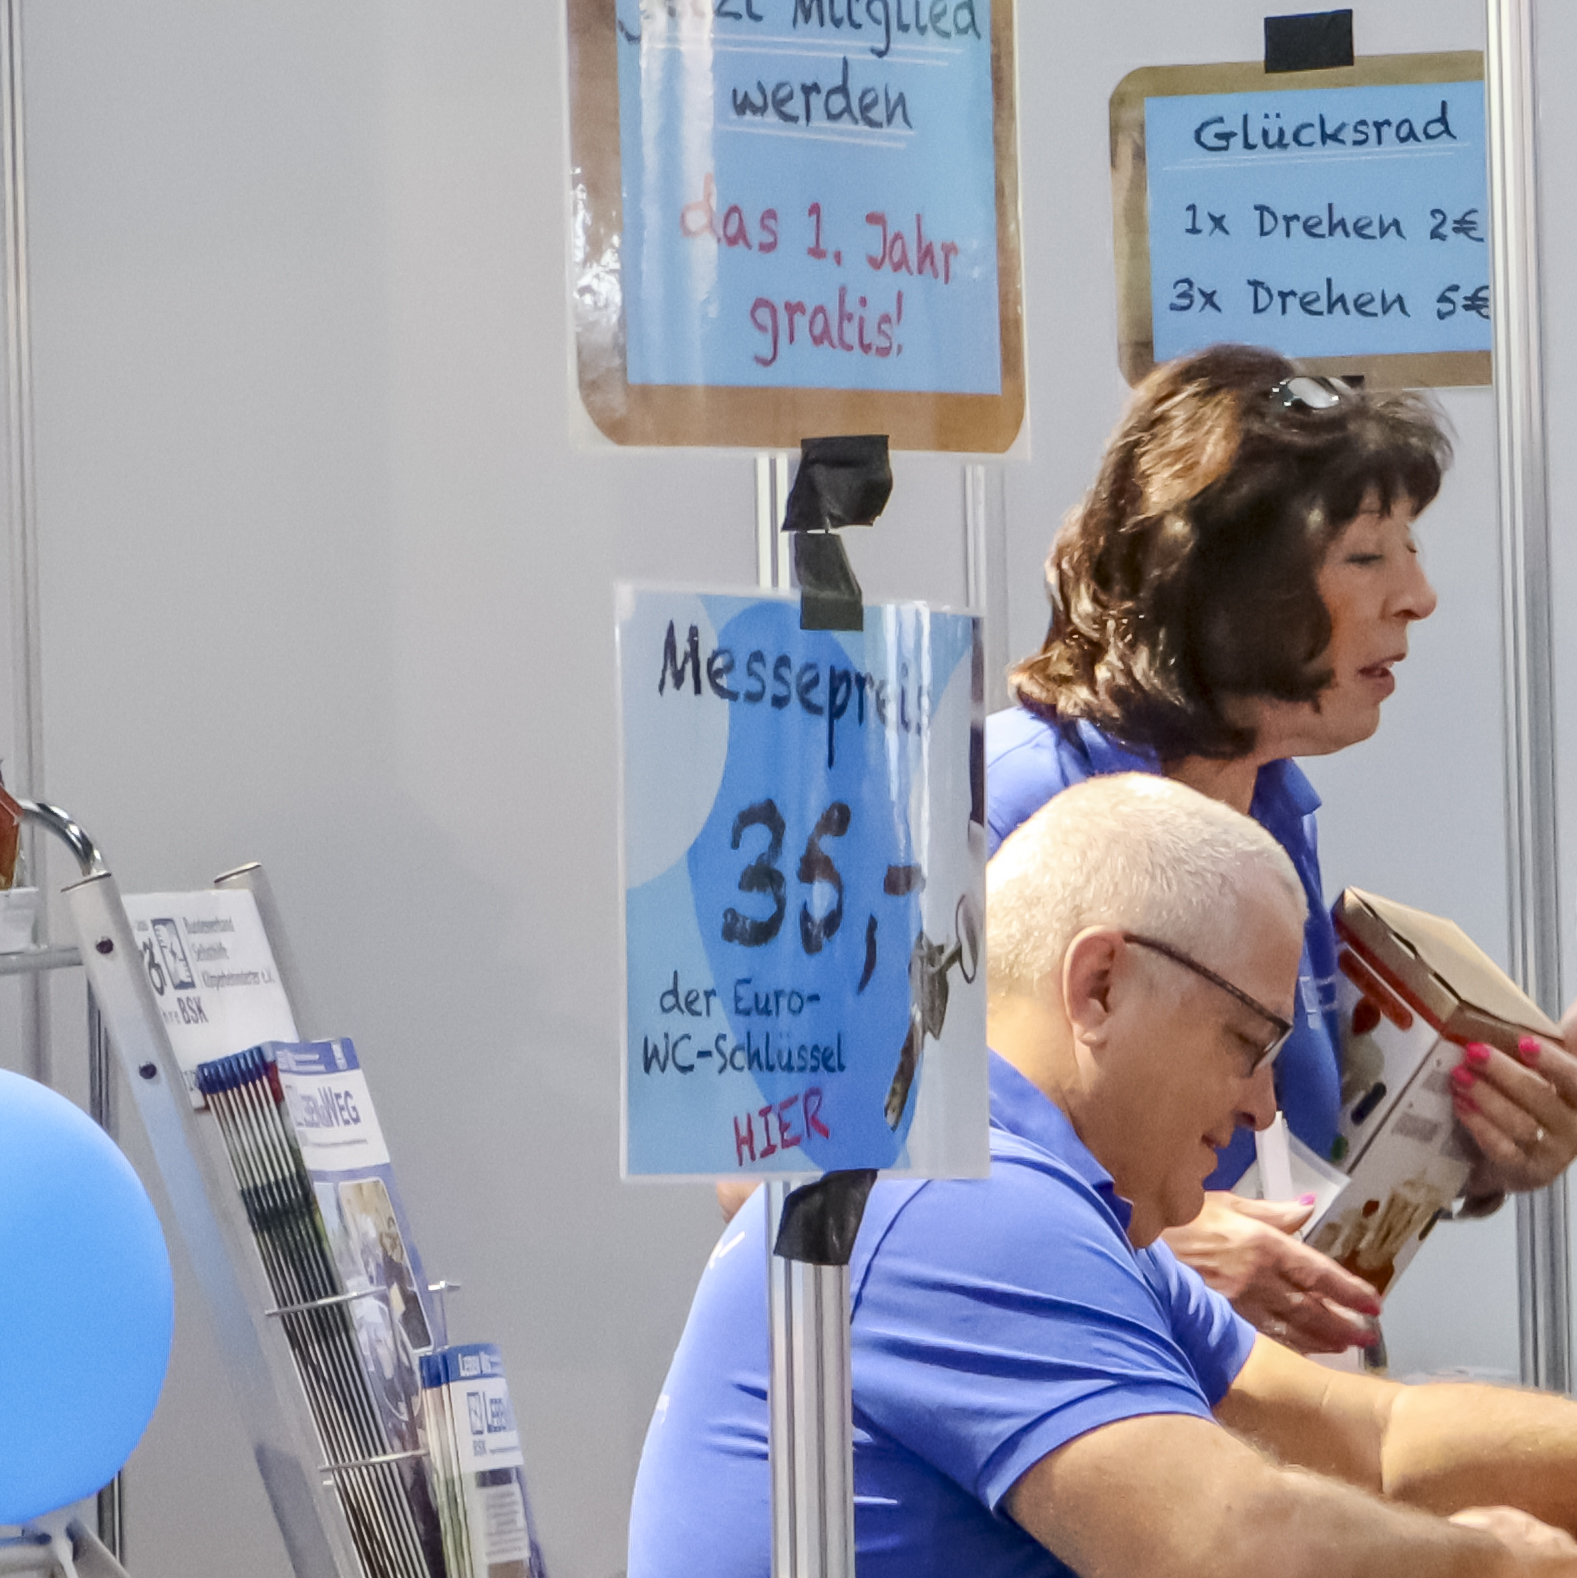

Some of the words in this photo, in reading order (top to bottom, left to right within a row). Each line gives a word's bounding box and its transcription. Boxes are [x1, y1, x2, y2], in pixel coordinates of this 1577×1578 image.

[732, 56, 913, 129] werden
[1193, 101, 1457, 152] Glücksrad
[680, 173, 779, 254] das
[807, 201, 843, 267] 1.
[865, 212, 960, 283] Jahr
[1183, 203, 1231, 238] 1x
[1257, 201, 1407, 242] Drehen
[1429, 206, 1486, 243] 2€
[1169, 278, 1223, 315] 3x
[1252, 276, 1410, 320] Drehen
[1435, 283, 1492, 322] 5€
[750, 288, 905, 367] gratis!
[658, 970, 717, 1018] der
[733, 977, 822, 1018] Euro-
[642, 1031, 847, 1076] WC-Schlüssel
[733, 1086, 830, 1167] HIER
